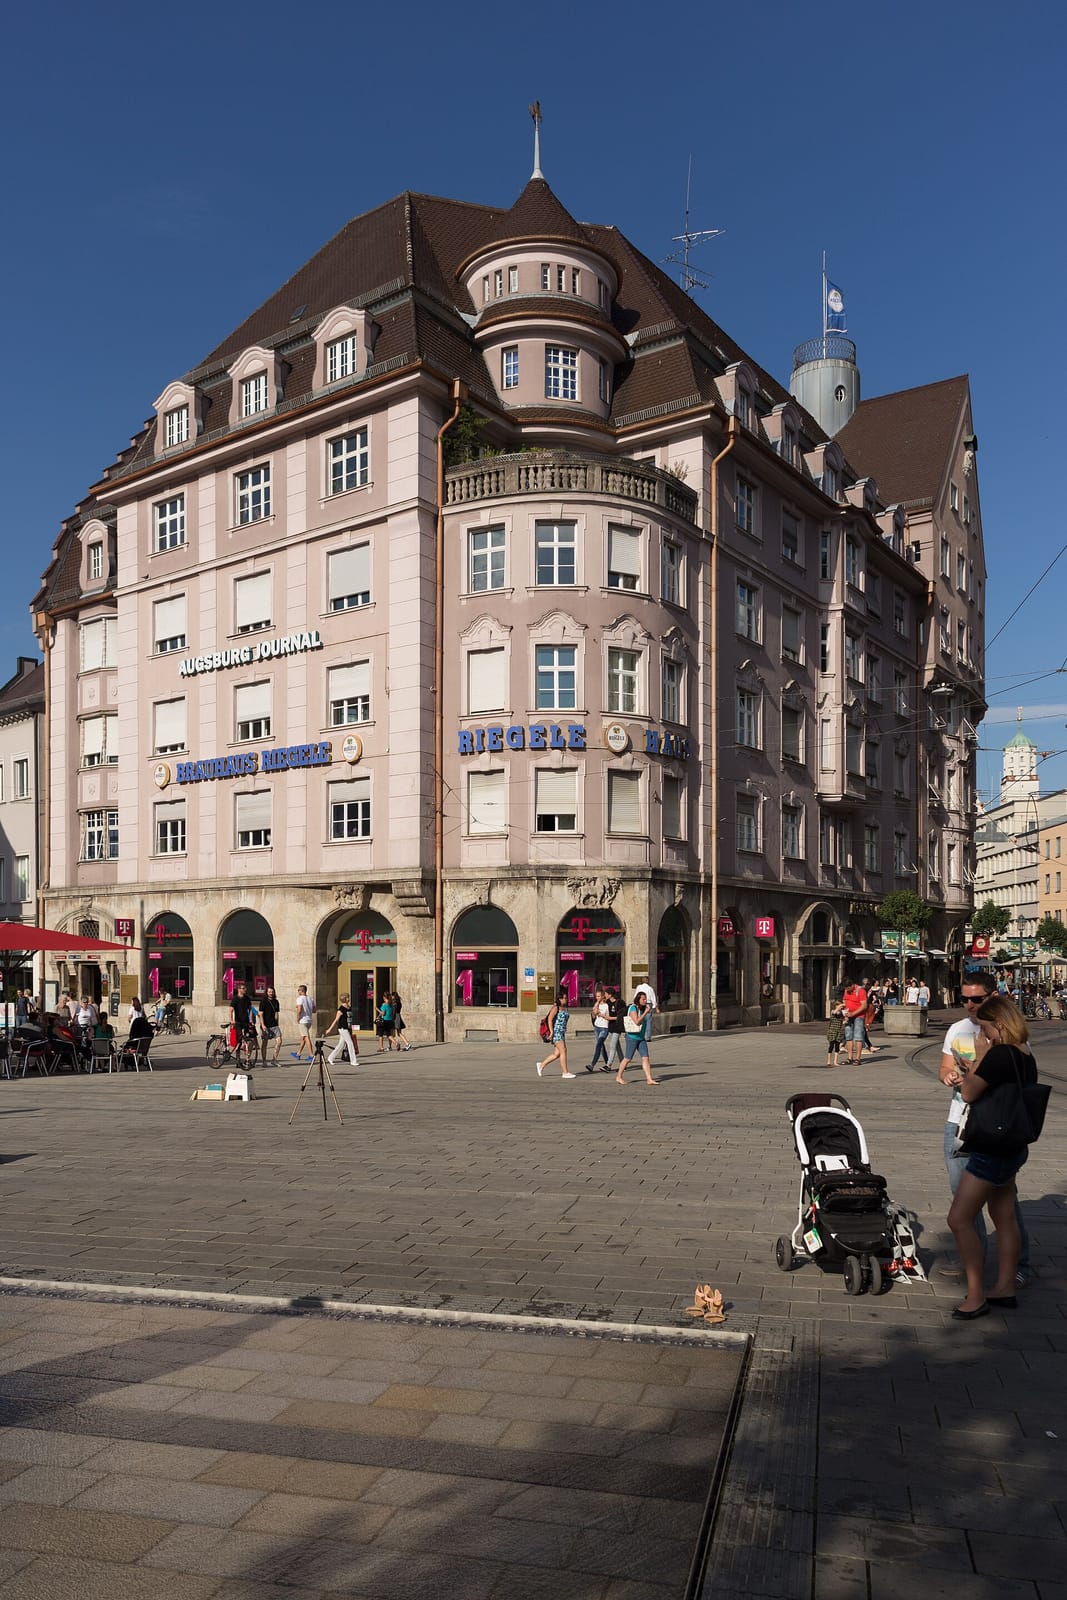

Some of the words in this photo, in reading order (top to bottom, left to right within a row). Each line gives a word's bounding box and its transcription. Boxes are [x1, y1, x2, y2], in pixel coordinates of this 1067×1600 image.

[178, 646, 251, 676] AUGSBURG
[255, 630, 322, 661] JOURNAL
[457, 724, 586, 753] RIEGELE
[176, 752, 257, 783] BRAUHAUS
[261, 741, 331, 771] RIEGELE
[119, 921, 130, 934] T
[154, 924, 166, 945] T
[355, 929, 371, 951] T
[571, 917, 590, 941] T
[758, 920, 770, 934] T
[222, 967, 235, 1000] 1
[455, 969, 473, 1006] 1
[559, 969, 580, 1007] 1
